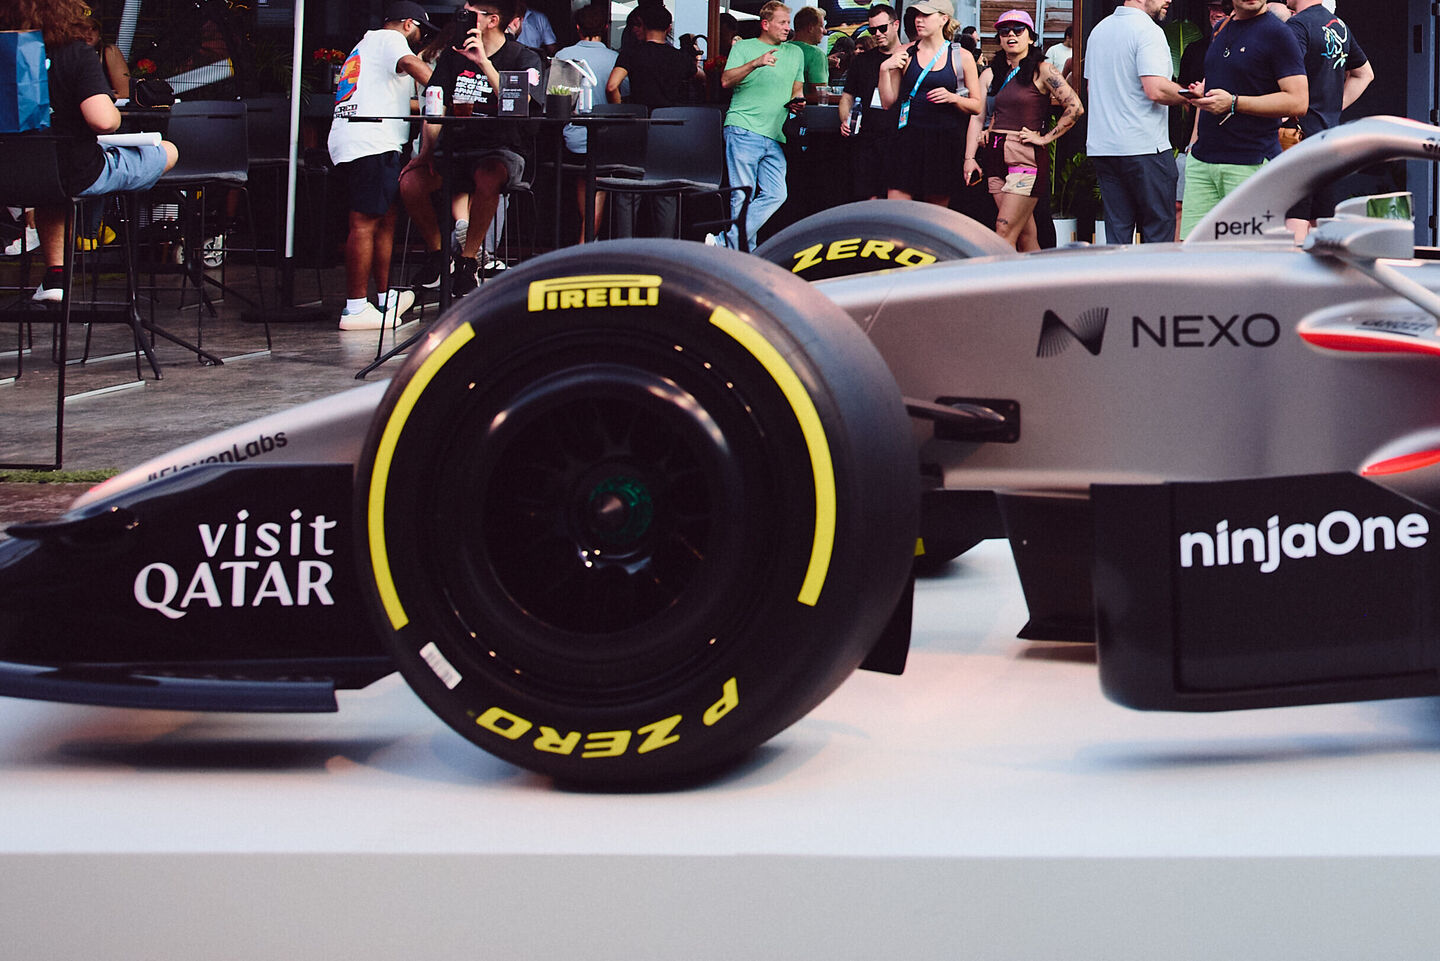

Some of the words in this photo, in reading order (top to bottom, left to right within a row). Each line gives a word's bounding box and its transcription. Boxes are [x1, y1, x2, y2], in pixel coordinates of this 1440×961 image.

[791, 238, 937, 272] ZERO
[528, 274, 662, 312] PIRELLI
[1132, 313, 1281, 348] NEXO
[198, 509, 337, 557] visit
[1180, 510, 1429, 574] ninjaOne
[134, 560, 334, 619] QATAR
[703, 676, 739, 727] P
[476, 707, 683, 758] ZERO
